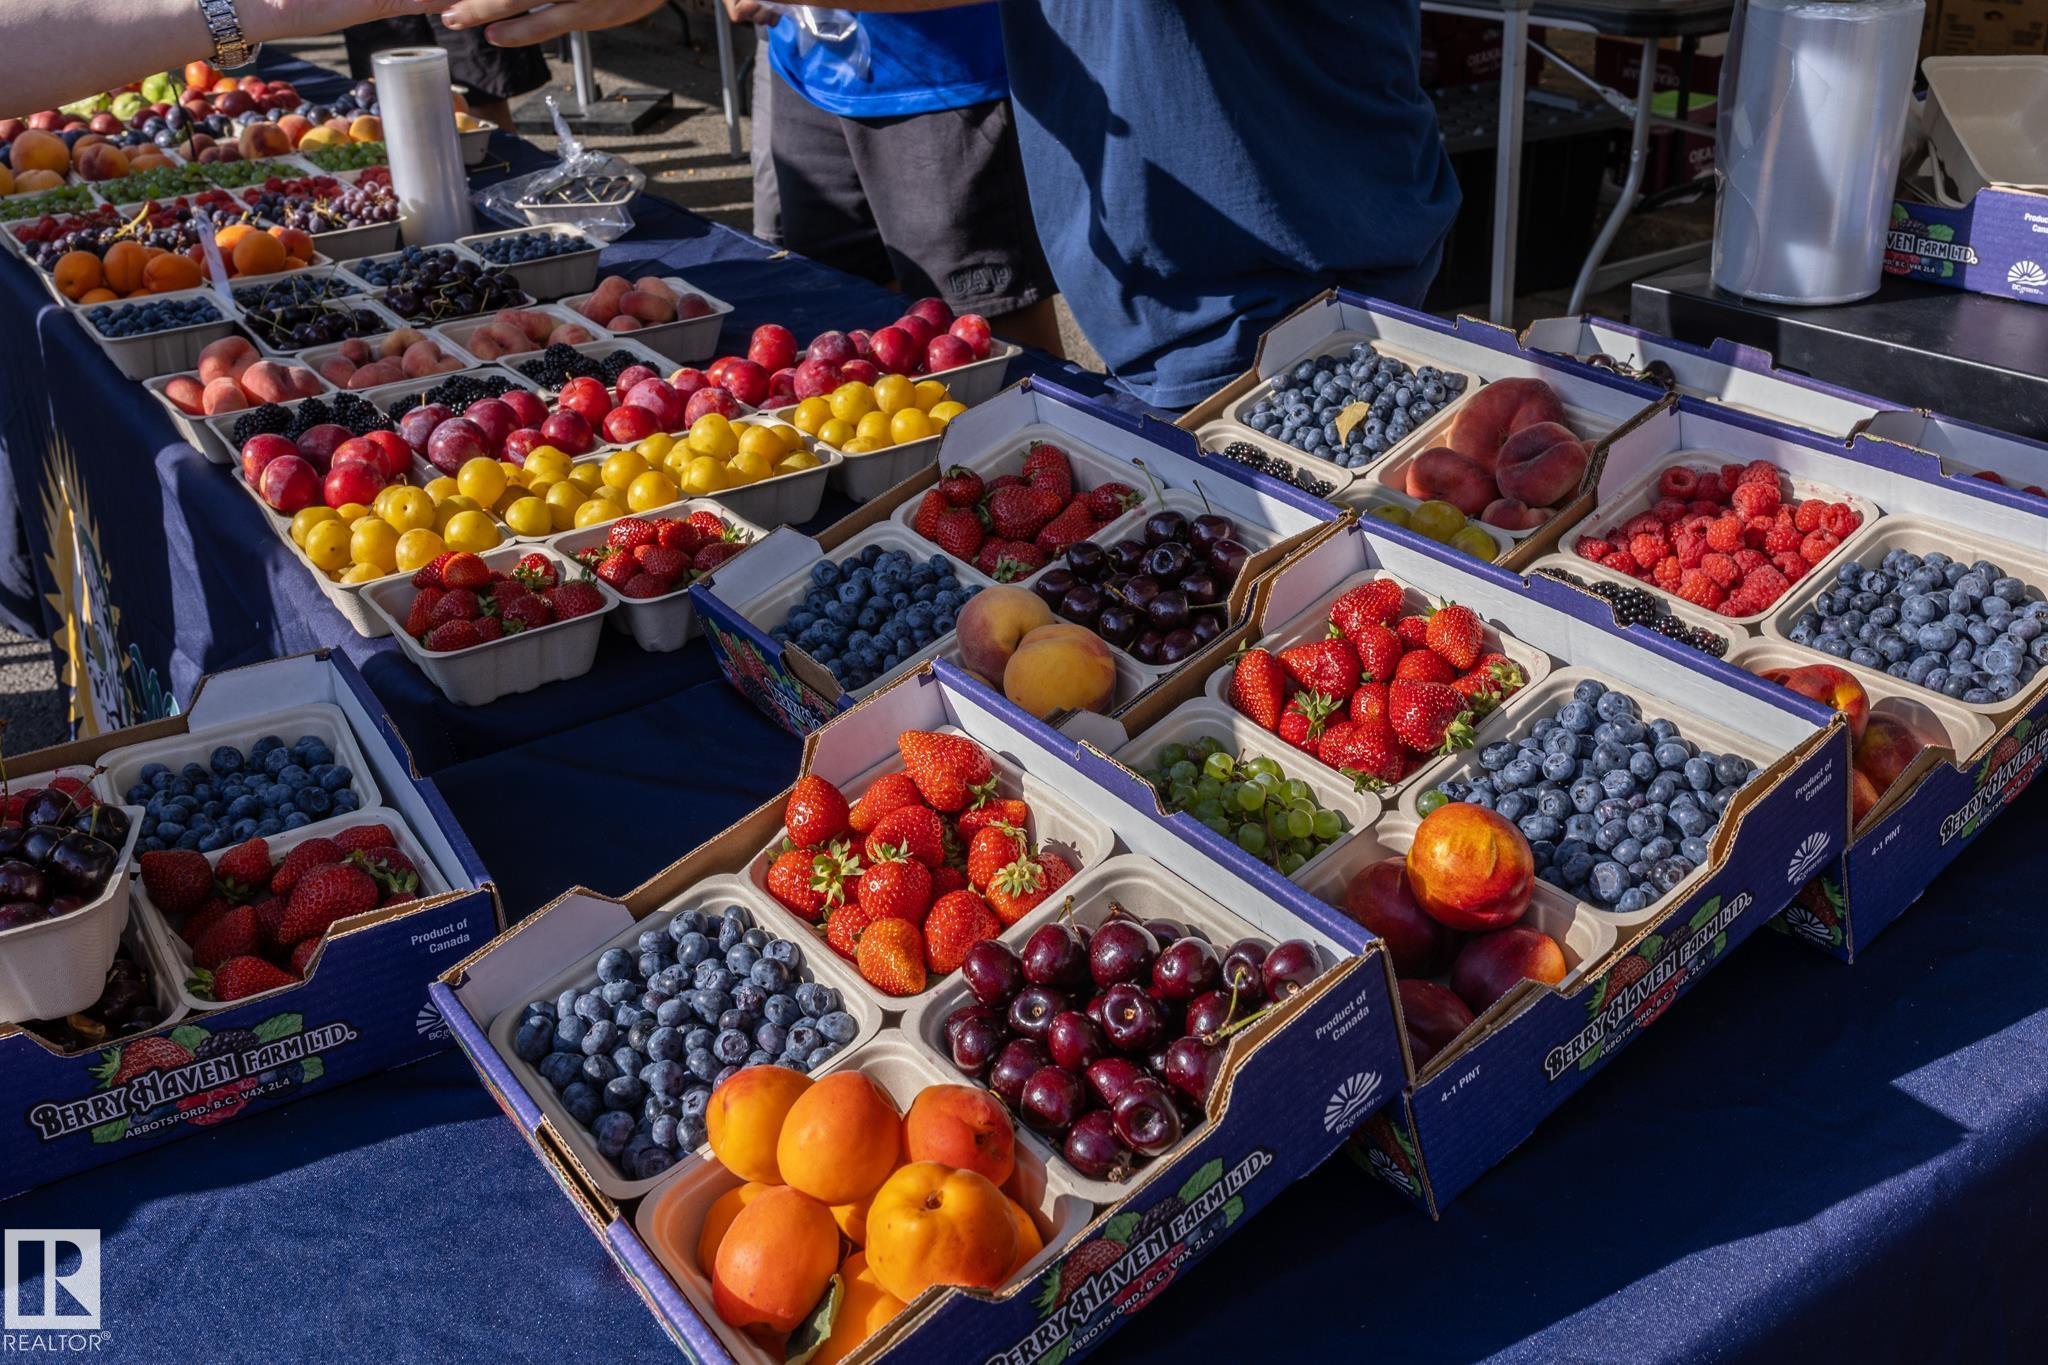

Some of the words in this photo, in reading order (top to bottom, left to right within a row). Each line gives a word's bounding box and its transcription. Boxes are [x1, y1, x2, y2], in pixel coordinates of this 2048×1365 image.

[1917, 239, 1949, 259] FARM
[1950, 246, 1978, 265] LTD.
[1795, 770, 1824, 800] Product
[1824, 758, 1832, 771] of
[1805, 772, 1832, 802] Canada
[1940, 786, 1987, 846] BERRY
[1985, 735, 2038, 802] HAVEN
[1871, 842, 1883, 856] 4-1
[1884, 824, 1901, 846] PINT
[410, 923, 455, 946] Product
[457, 918, 469, 930] of
[429, 933, 471, 954] Canada
[1545, 1011, 1608, 1081] BERRY
[1607, 951, 1677, 1029] HAVEN
[1680, 918, 1718, 966] FARM
[1719, 892, 1753, 931] LTD.
[1674, 974, 1690, 991] V4X
[1691, 958, 1706, 975] 2L4
[1315, 1002, 1356, 1041] Product
[1356, 990, 1368, 1008] of
[1332, 1005, 1370, 1042] Canada
[31, 1089, 128, 1140] BERRY
[130, 1053, 240, 1112] HAVEN
[245, 1037, 304, 1074] FARM
[304, 1022, 358, 1054] LTD.
[1440, 1086, 1457, 1102] 4-1
[1459, 1065, 1481, 1089] PINT
[124, 1104, 211, 1139] ABBOTSFORD,
[213, 1096, 238, 1110] B.C.
[240, 1087, 266, 1101] V4X
[268, 1078, 290, 1092] 2L4
[1070, 1227, 1168, 1324] HAVEN
[1171, 1186, 1226, 1242] FARM
[1225, 1150, 1273, 1197] LTD.
[1066, 1288, 1146, 1358] ABBOTSFORD,
[1169, 1249, 1193, 1271] V4X
[1194, 1230, 1215, 1252] 2L4
